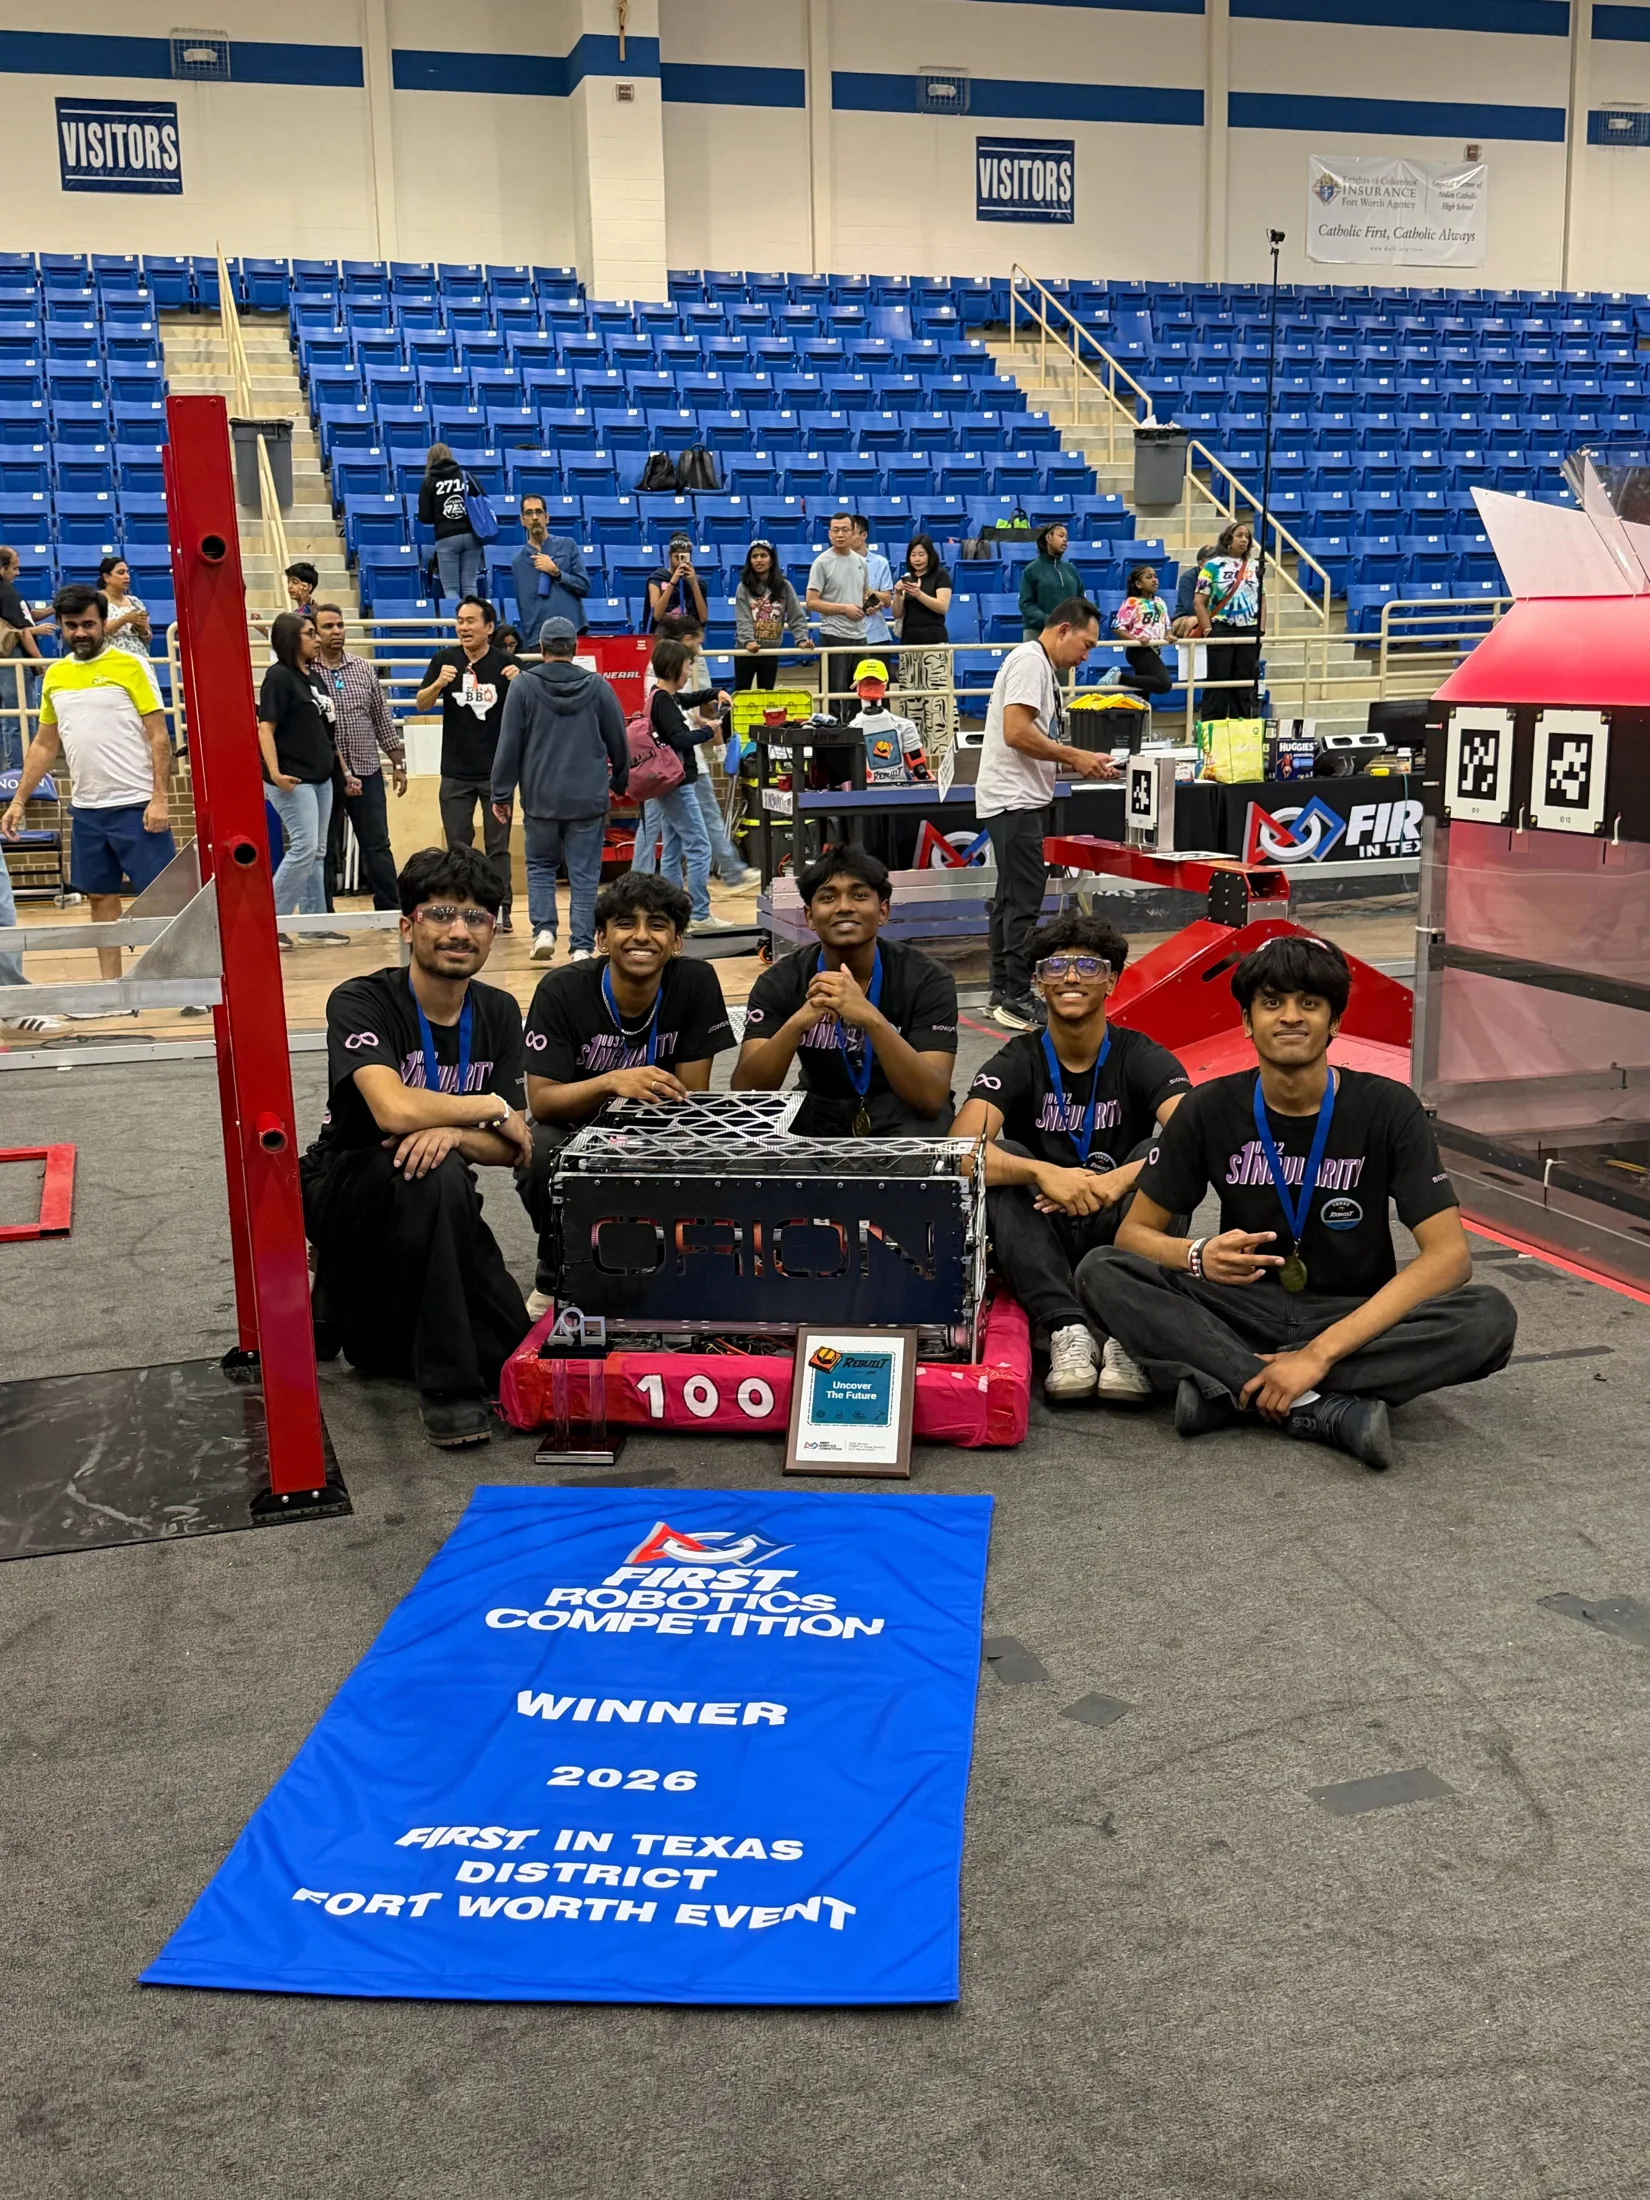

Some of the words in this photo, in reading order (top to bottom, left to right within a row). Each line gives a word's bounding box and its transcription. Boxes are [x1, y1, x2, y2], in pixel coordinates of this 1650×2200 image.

[61, 121, 178, 171] VISITORS
[978, 158, 1072, 202] VISITORS
[1342, 186, 1417, 198] INSURANCE
[1341, 197, 1358, 206] Fort
[1360, 198, 1385, 207] Worth
[1386, 199, 1416, 210] Agency
[1442, 203, 1455, 211] High
[1318, 224, 1362, 238] Catholic
[1364, 226, 1390, 240] First,
[1393, 226, 1436, 241] Catholic
[1438, 228, 1476, 245] Always
[602, 671, 641, 680] NERAL
[1279, 742, 1315, 752] HUGGIES
[1345, 800, 1424, 846] FIR
[1359, 844, 1380, 858] IN
[1386, 840, 1422, 855] TEX
[590, 1216, 935, 1280] ORION
[842, 1357, 890, 1369] REBUILT
[636, 1374, 774, 1418] 100
[826, 1390, 844, 1399] The
[846, 1391, 877, 1400] Future
[832, 1381, 872, 1390] Uncover
[601, 1566, 799, 1591] FIRST
[543, 1588, 837, 1613] ROBOTICS
[485, 1608, 885, 1639] COMPETITION
[517, 1690, 788, 1726] WINNER
[546, 1765, 698, 1791] 2026
[393, 1826, 540, 1850] FIRST
[553, 1829, 614, 1852] IN
[631, 1833, 804, 1861] TEXAS
[455, 1860, 718, 1890] DISTRICT
[291, 1887, 443, 1917] FORT
[458, 1895, 657, 1921] WORTH
[674, 1896, 857, 1931] EVENT
